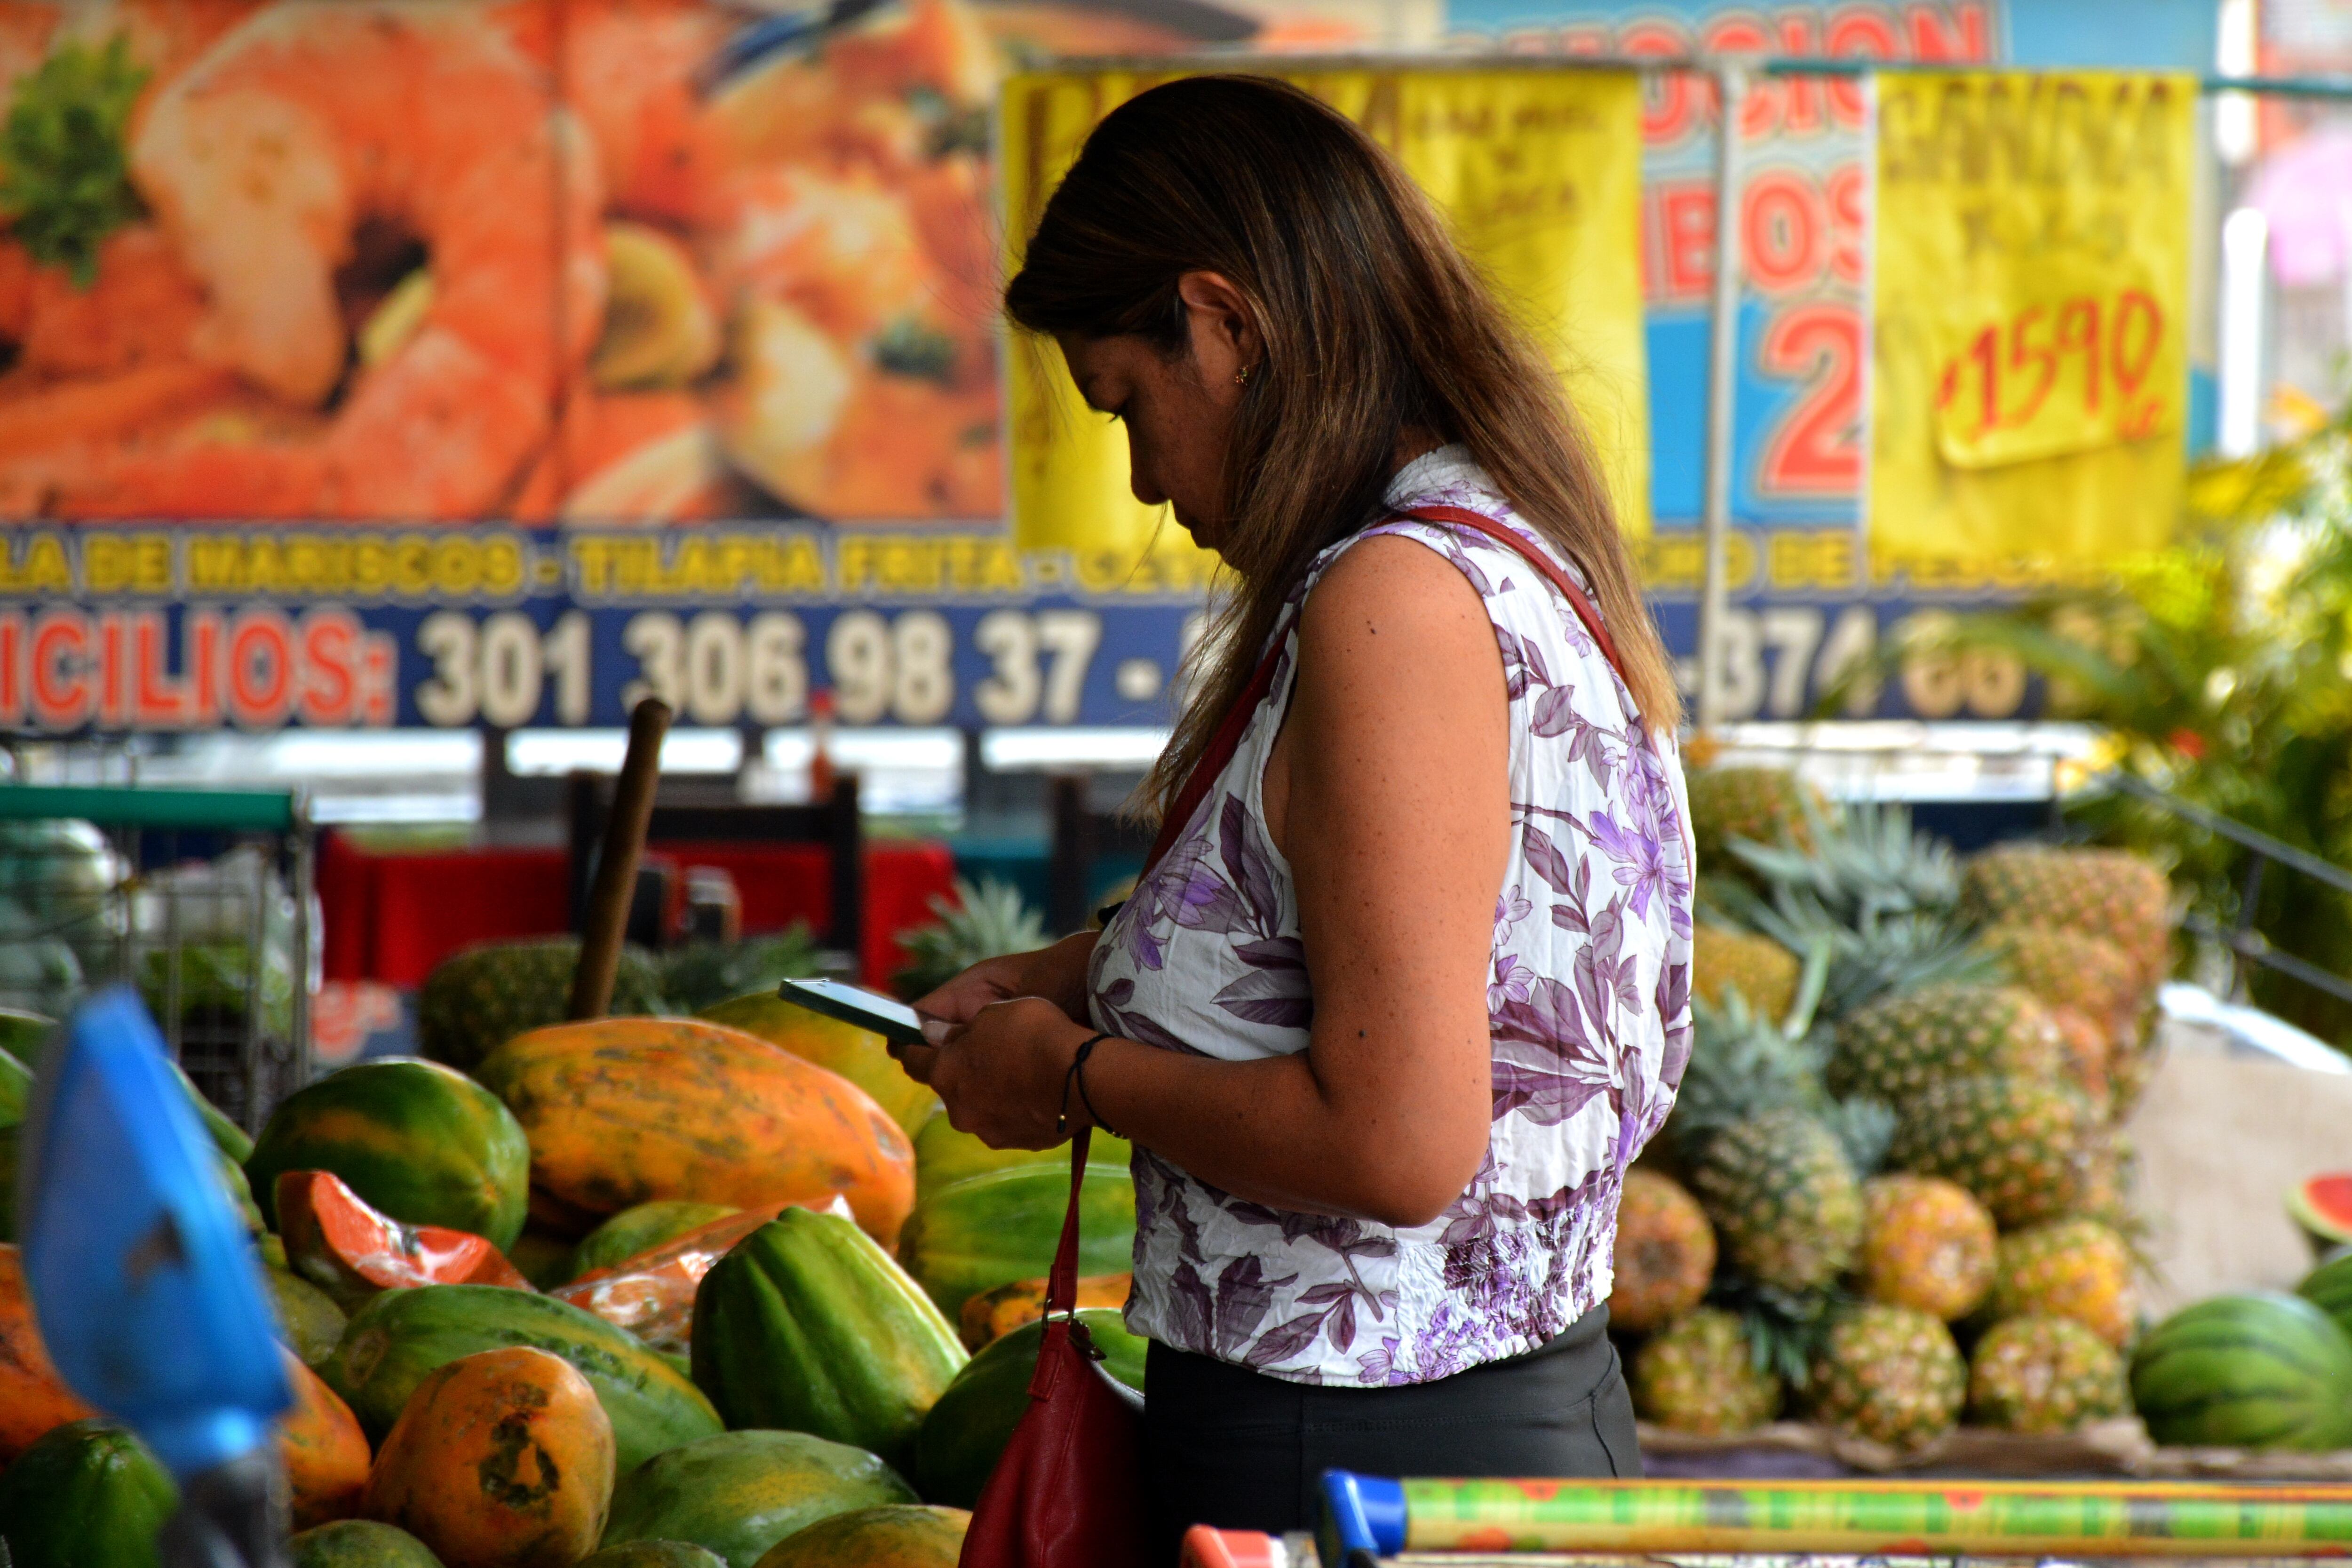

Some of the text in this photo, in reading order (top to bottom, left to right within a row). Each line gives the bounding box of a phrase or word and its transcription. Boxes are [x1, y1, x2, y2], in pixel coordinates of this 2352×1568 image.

[84, 533, 171, 594] DE
[188, 533, 524, 596] MARISCOS
[572, 535, 823, 595] TILAPIA
[839, 536, 1023, 595] FRITA
[416, 611, 592, 727] 301
[621, 610, 808, 726] 306
[825, 610, 953, 726] 98
[974, 610, 1104, 726] 37
